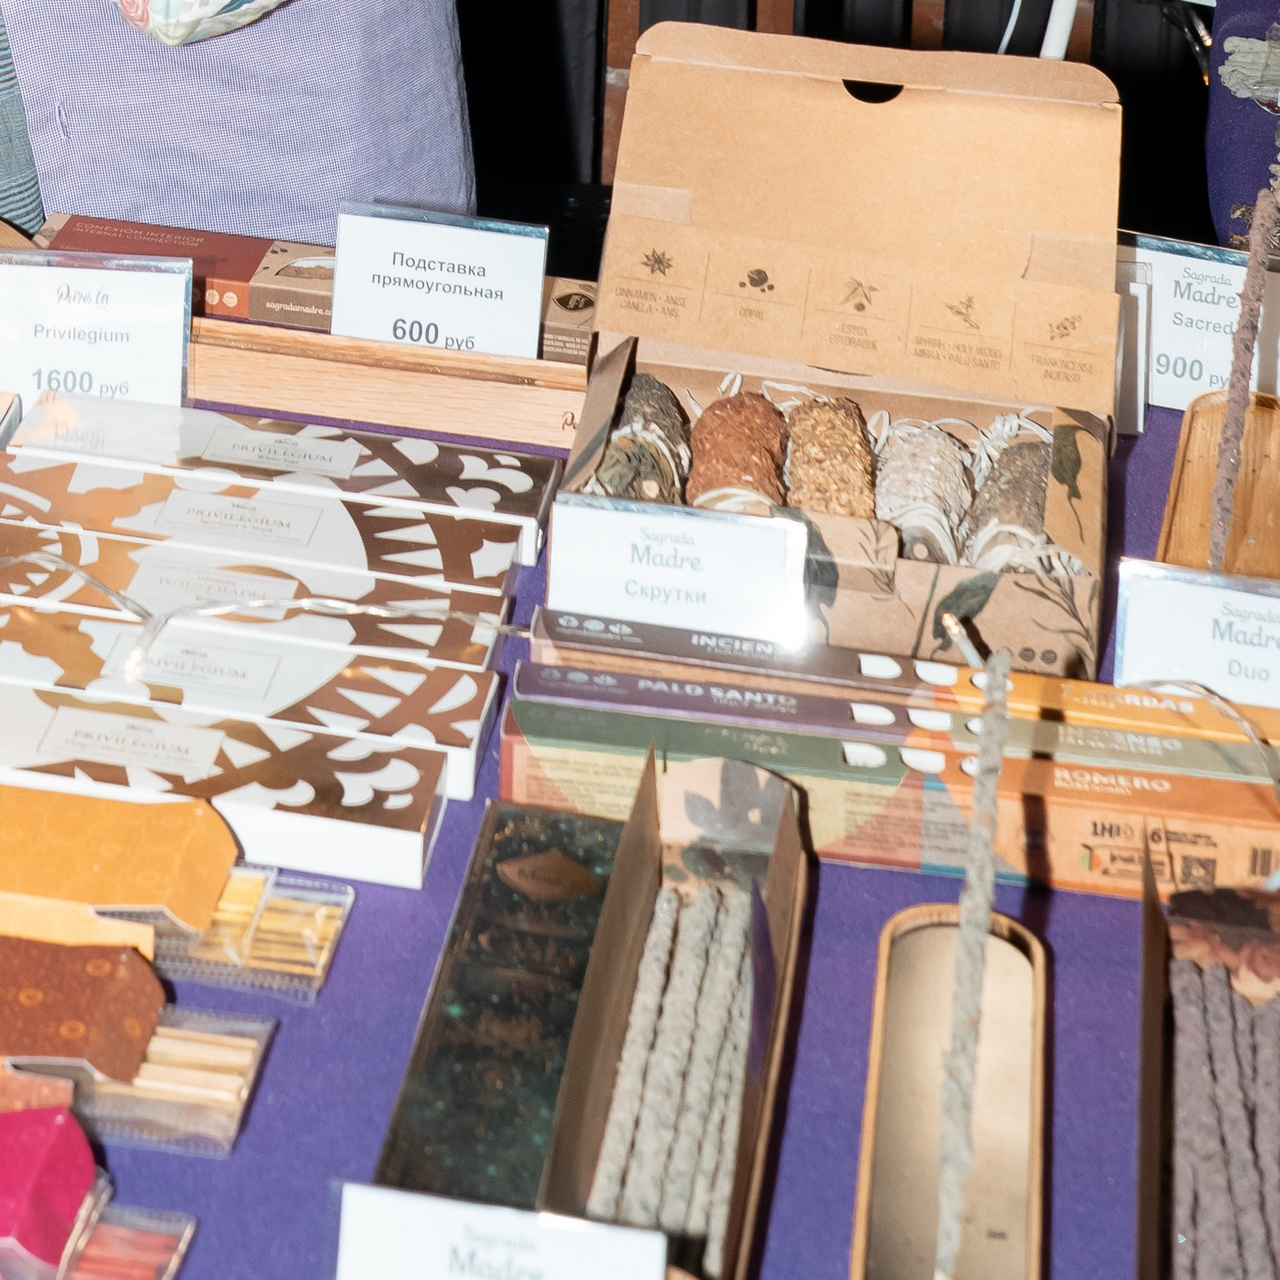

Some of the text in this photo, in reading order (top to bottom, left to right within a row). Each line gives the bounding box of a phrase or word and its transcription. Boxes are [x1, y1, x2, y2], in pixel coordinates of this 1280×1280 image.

[392, 251, 487, 278] Подставка
[1182, 267, 1232, 286] Sagrada
[370, 270, 504, 302] прямоугольная
[1173, 280, 1239, 308] Madre
[739, 307, 765, 321] COPAL
[1172, 312, 1235, 335] Sacred
[33, 322, 131, 345] Privilegium
[392, 317, 476, 352] 600 руб
[31, 368, 130, 398] 1600 руб
[1156, 353, 1229, 389] 900 ру
[185, 506, 295, 530] PRIVILEGIUM
[640, 527, 694, 545] Sagrada
[630, 542, 704, 571] Madre
[625, 579, 707, 604] Скрутки
[691, 633, 775, 656] INCIEN
[139, 654, 248, 681] RIVILEGIUM
[1228, 659, 1270, 681] Duo
[638, 677, 797, 707] PALO SANTO
[73, 728, 191, 756] PRIVILEGIUM
[1053, 767, 1172, 793] ROMERO
